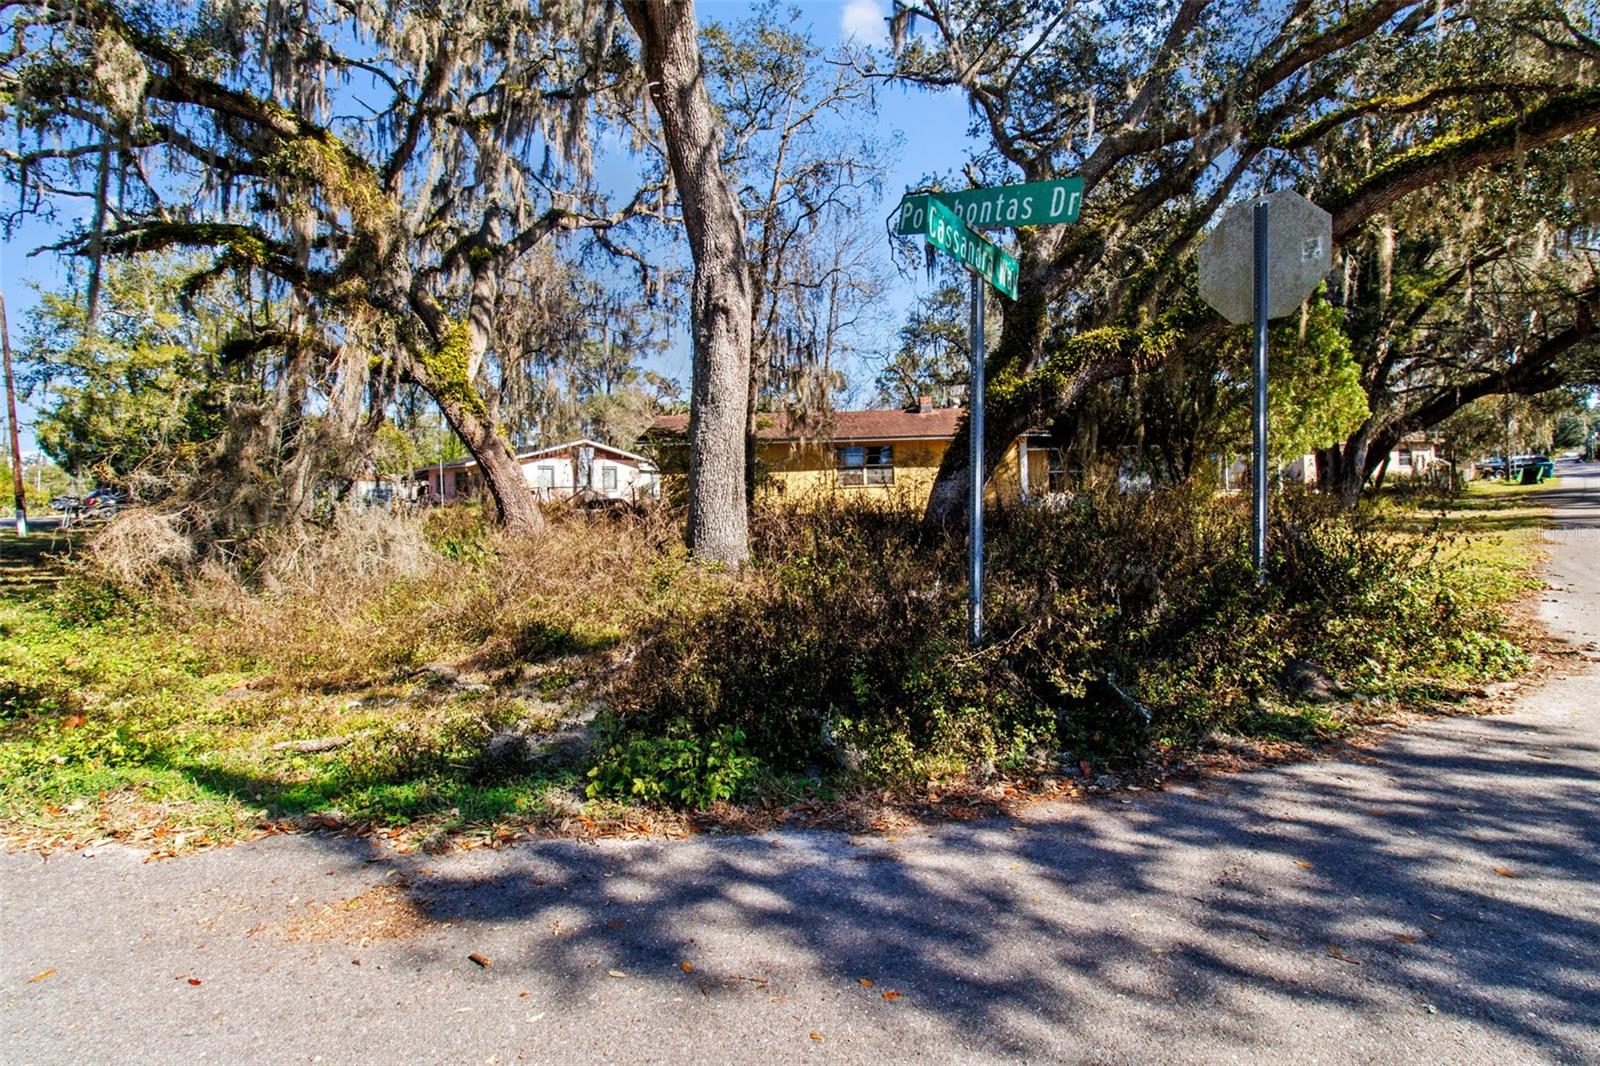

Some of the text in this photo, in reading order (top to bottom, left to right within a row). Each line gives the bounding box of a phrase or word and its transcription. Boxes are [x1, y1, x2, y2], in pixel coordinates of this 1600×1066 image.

[900, 187, 1080, 230] Pohontas Dr
[929, 206, 993, 277] Cassandra
